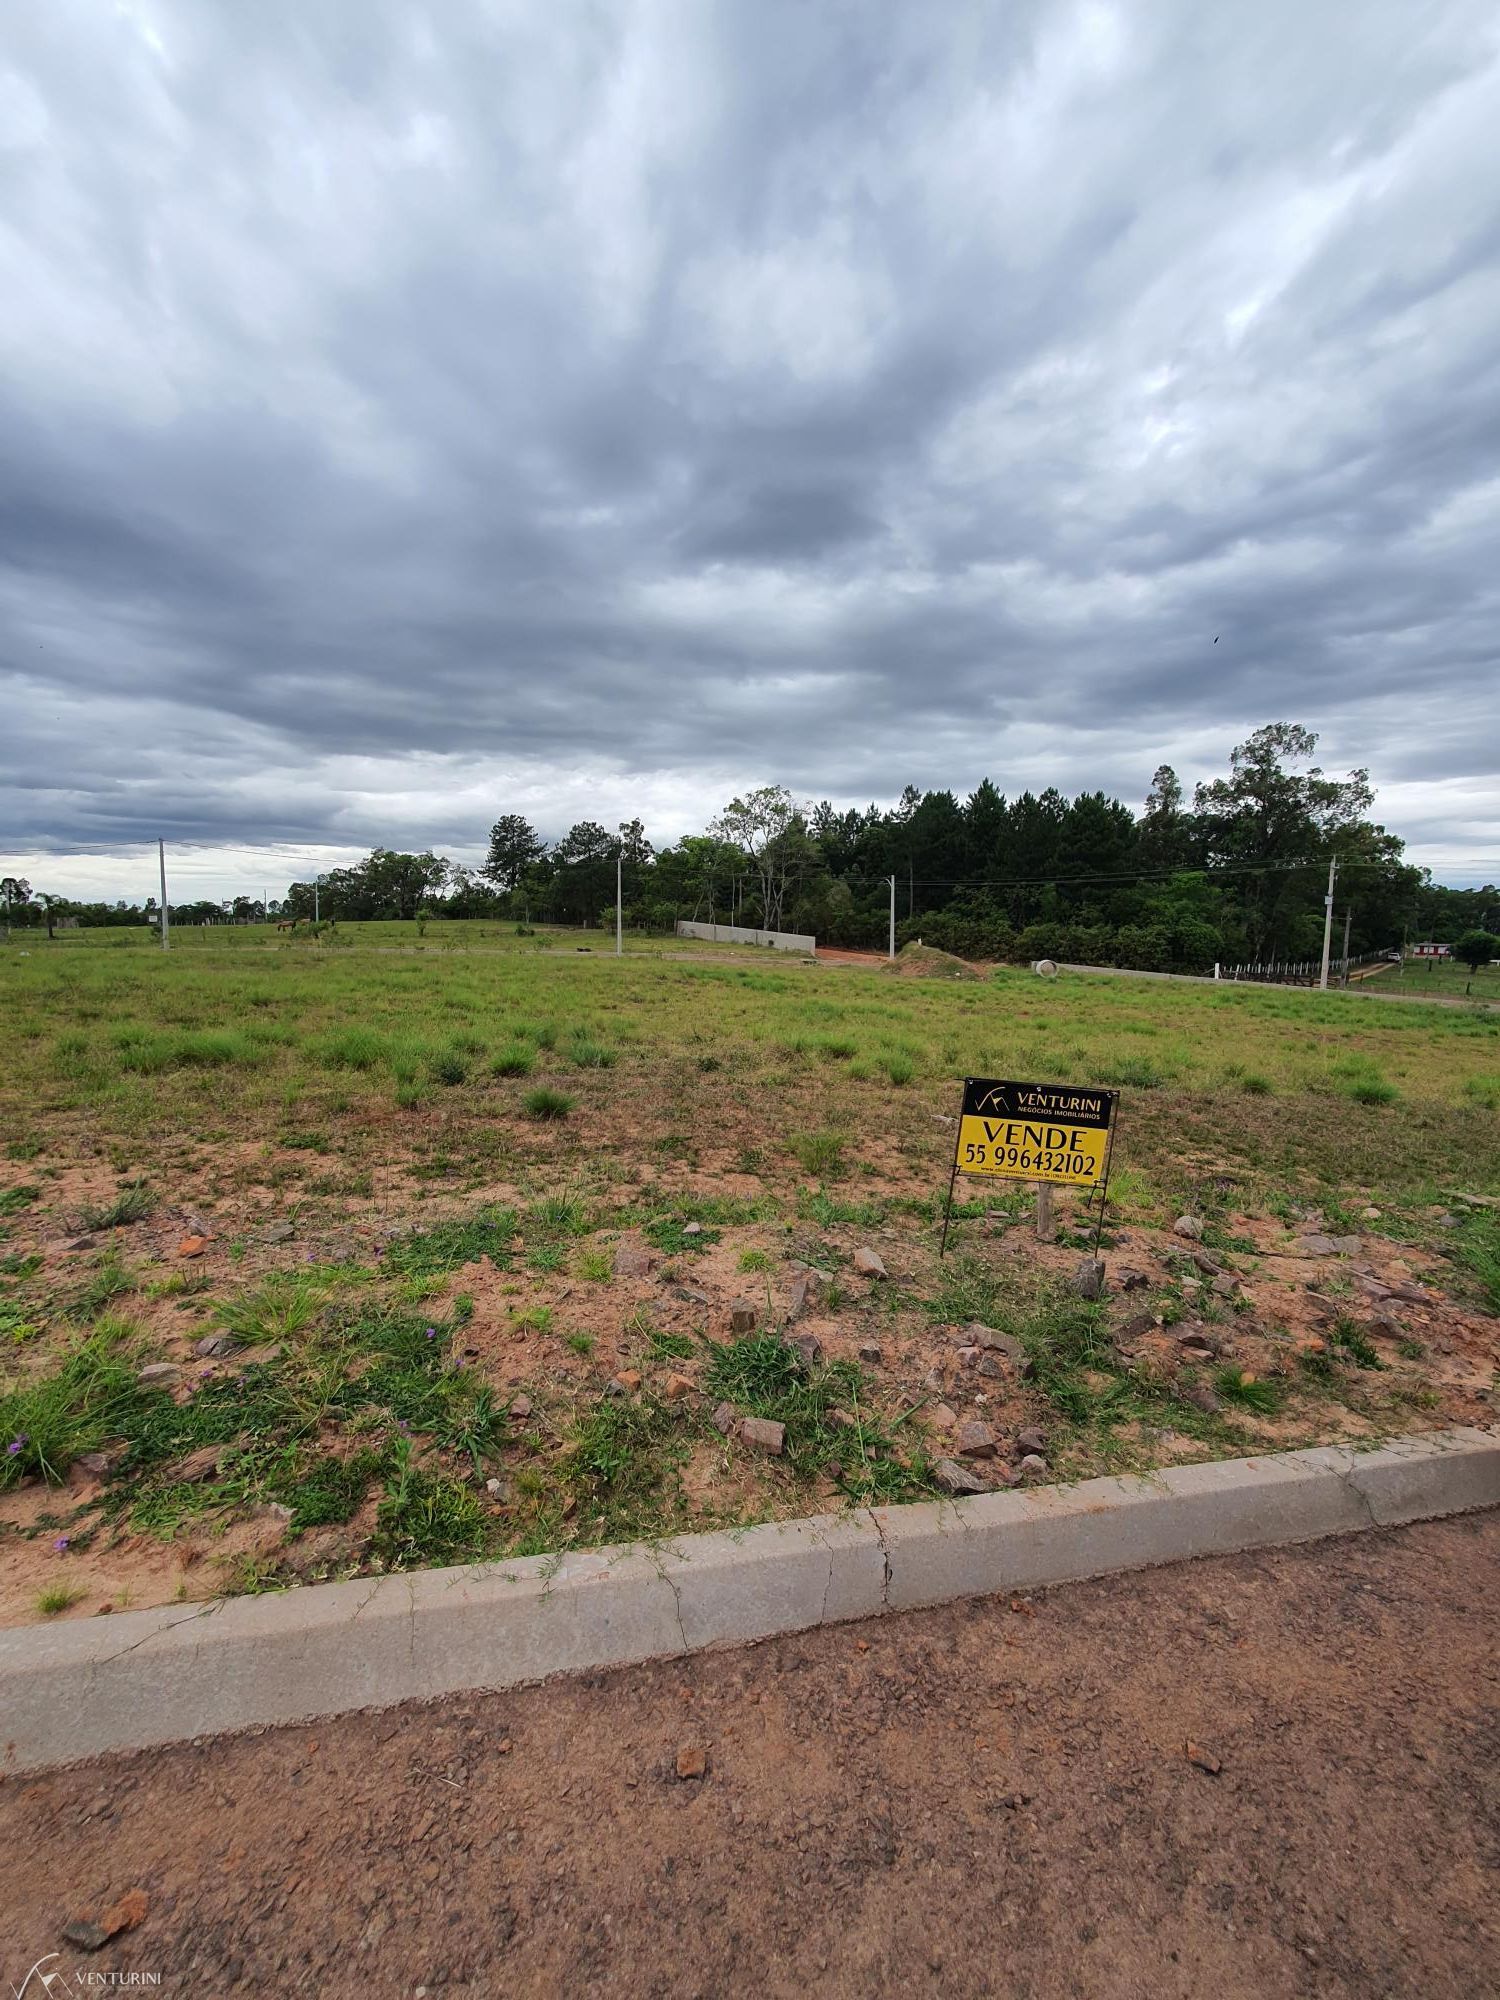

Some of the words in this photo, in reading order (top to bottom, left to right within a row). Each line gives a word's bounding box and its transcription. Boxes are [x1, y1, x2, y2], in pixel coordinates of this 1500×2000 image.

[1017, 1091, 1101, 1112] VENTURINI
[982, 1121, 1088, 1153] VENDE
[965, 1143, 986, 1164] 55
[994, 1146, 1096, 1176] 996432102
